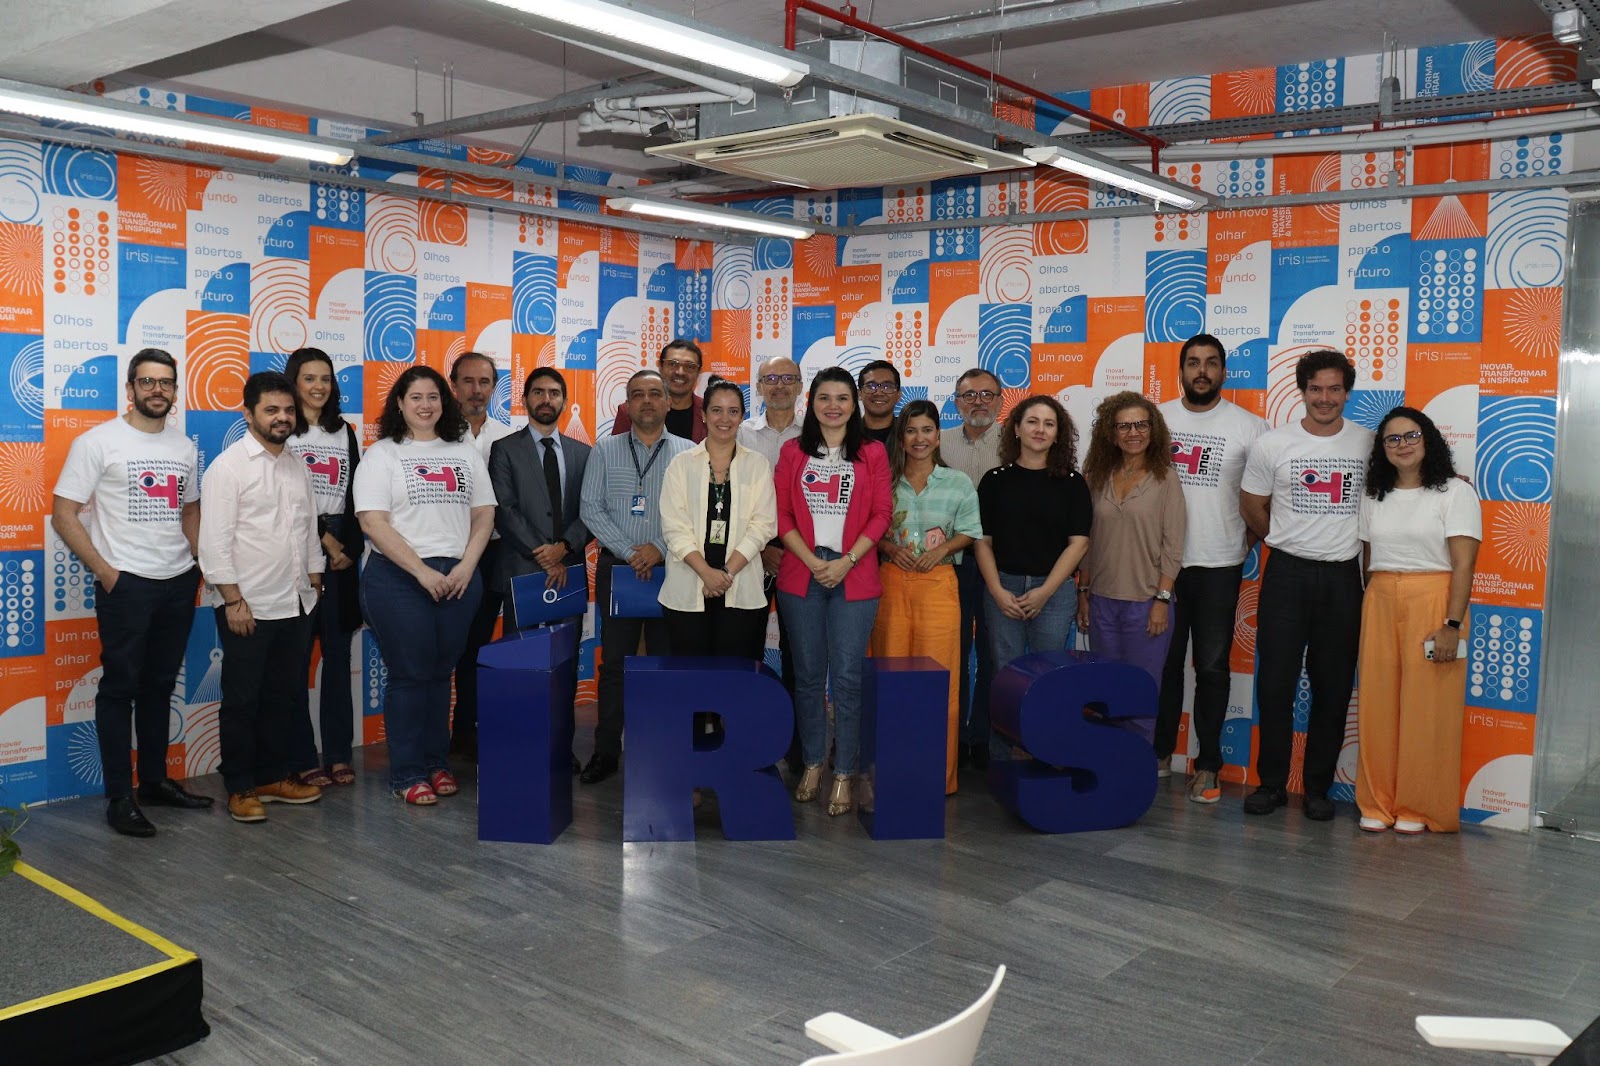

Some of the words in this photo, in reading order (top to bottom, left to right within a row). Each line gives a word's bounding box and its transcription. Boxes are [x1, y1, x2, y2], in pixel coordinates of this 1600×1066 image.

[195, 168, 222, 180] para
[258, 193, 302, 207] abertos
[1241, 207, 1269, 218] novo
[118, 217, 177, 231] TRANSFORMAR
[257, 215, 283, 227] para
[286, 219, 294, 227] o
[125, 224, 162, 235] INSPIRAR
[194, 222, 229, 236] Olhos
[1349, 221, 1402, 233] abertos
[1215, 230, 1246, 241] olhar
[258, 234, 294, 249] futuro
[563, 236, 584, 247] olhar
[194, 244, 242, 259] abertos
[643, 250, 671, 260] abertos
[888, 248, 923, 258] abertos
[1348, 244, 1378, 256] para
[1382, 245, 1390, 254] o
[423, 251, 450, 263] Olhos
[563, 255, 579, 265] para
[1215, 252, 1242, 264] para
[194, 268, 222, 280] para
[225, 272, 233, 280] o
[643, 267, 659, 276] para
[887, 268, 908, 278] para
[1039, 265, 1068, 275] Olhos
[1348, 267, 1390, 278] futuro
[423, 272, 460, 283] abertos
[841, 275, 856, 284] Um
[859, 274, 879, 283] novo
[1215, 273, 1256, 283] mundo
[643, 283, 666, 293] futuro
[887, 286, 916, 296] futuro
[1039, 284, 1080, 294] abertos
[194, 290, 234, 303] futuro
[423, 291, 445, 302] para
[841, 292, 864, 301] olhar
[561, 298, 584, 307] Olhos
[1039, 304, 1062, 315] para
[1065, 304, 1072, 313] o
[1214, 305, 1247, 315] Olhos
[53, 314, 93, 327] Olhos
[423, 311, 453, 321] futuro
[561, 316, 592, 326] abertos
[841, 311, 860, 321] para
[1039, 324, 1072, 334] futuro
[1214, 326, 1261, 335] abertos
[315, 330, 345, 342] Olhos
[561, 335, 579, 344] para
[581, 336, 586, 344] o
[53, 339, 108, 352] abertos
[561, 352, 586, 361] futuro
[1038, 353, 1055, 362] Um
[1058, 354, 1083, 362] novo
[1243, 349, 1251, 357] o
[934, 355, 961, 364] Olhos
[53, 362, 85, 374] para
[89, 365, 98, 374] o
[934, 374, 959, 383] abert
[1038, 373, 1064, 382] olhar
[53, 386, 98, 398] futuro
[1198, 447, 1212, 475] anos
[839, 474, 851, 504] anos
[1341, 472, 1352, 504] anos
[1473, 579, 1534, 590] RANSFORMAR
[1475, 586, 1517, 596] INSPIRAR
[55, 632, 78, 643] Um
[55, 654, 91, 666] olhar
[56, 678, 87, 691] para
[56, 700, 94, 712] mund
[0, 746, 45, 755] ransformar
[1482, 788, 1506, 798] Inovar
[1481, 796, 1529, 809] Transformar
[1481, 803, 1511, 814] Inspirar
